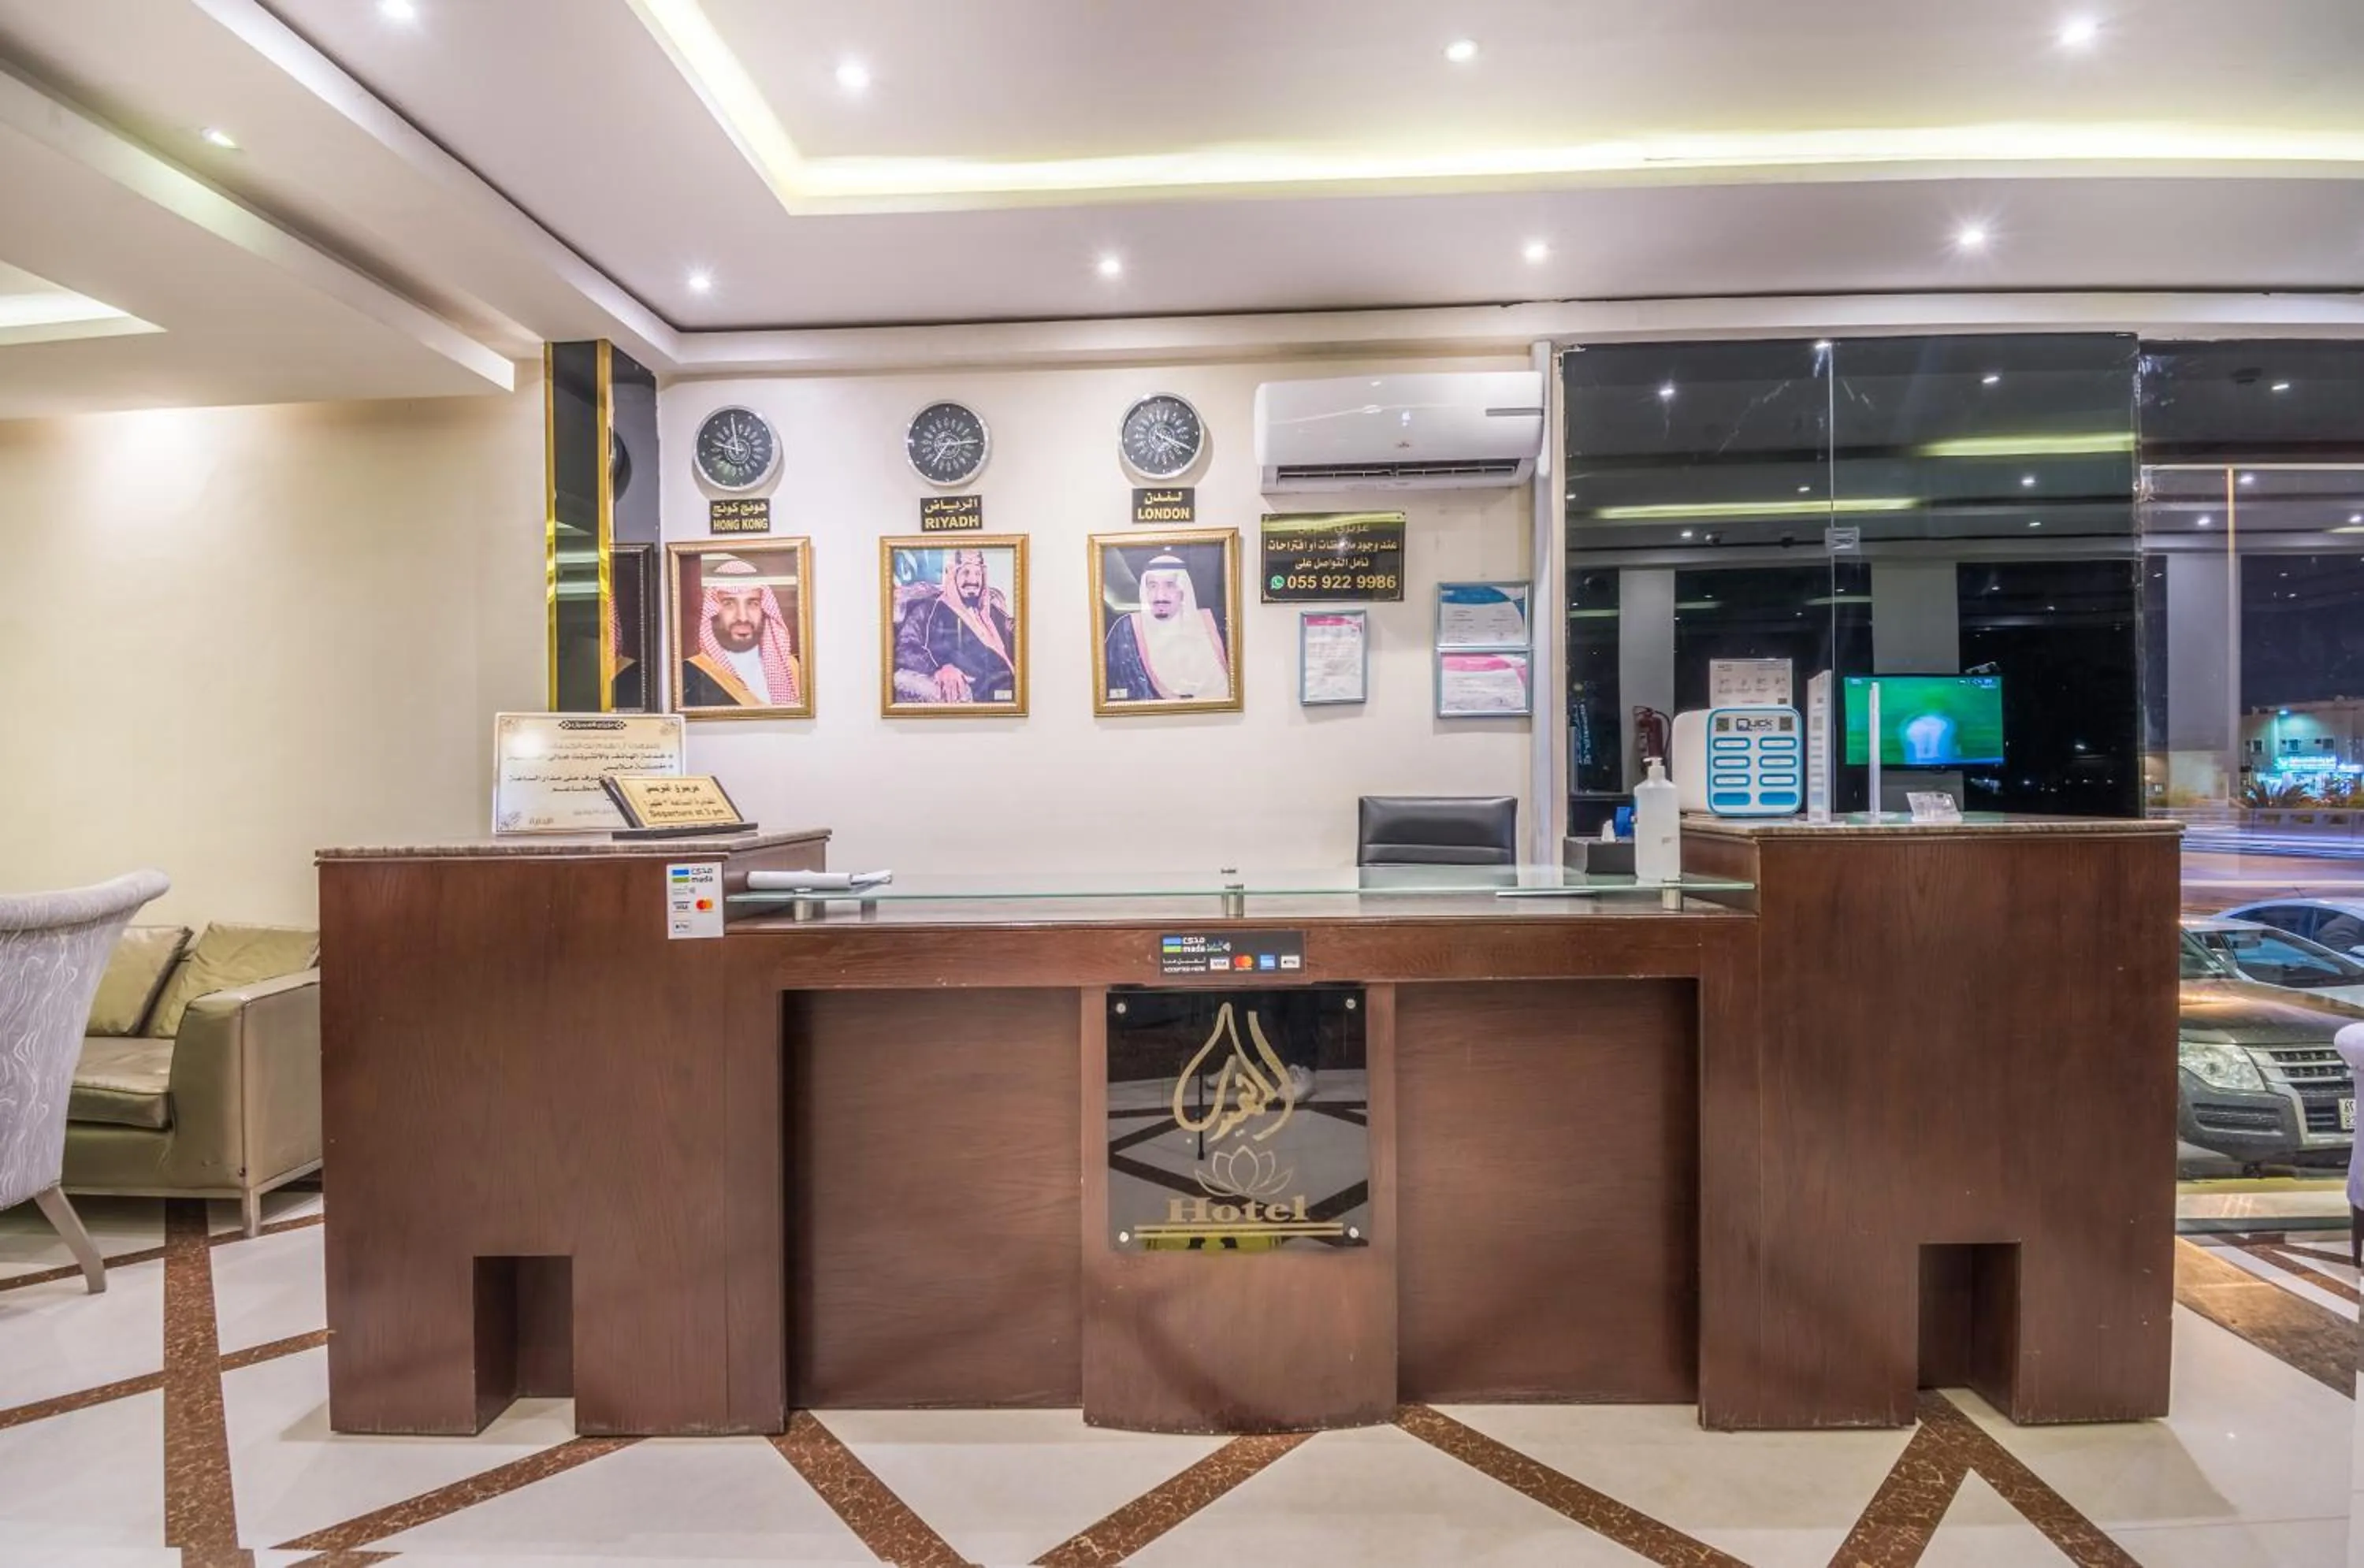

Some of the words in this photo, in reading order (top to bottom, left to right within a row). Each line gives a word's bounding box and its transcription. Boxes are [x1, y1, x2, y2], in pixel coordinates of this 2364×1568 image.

[1144, 491, 1183, 505] لندن
[924, 498, 978, 514] الرياض
[1137, 507, 1191, 520] LONDON
[713, 518, 740, 530] HONG
[742, 517, 768, 530] KONG
[924, 515, 979, 529] RIYADH
[1295, 557, 1312, 570] على
[1287, 575, 1317, 589] 055
[1321, 575, 1351, 589] 922
[1356, 574, 1397, 589] 9986
[1168, 1195, 1310, 1223] Hotel
